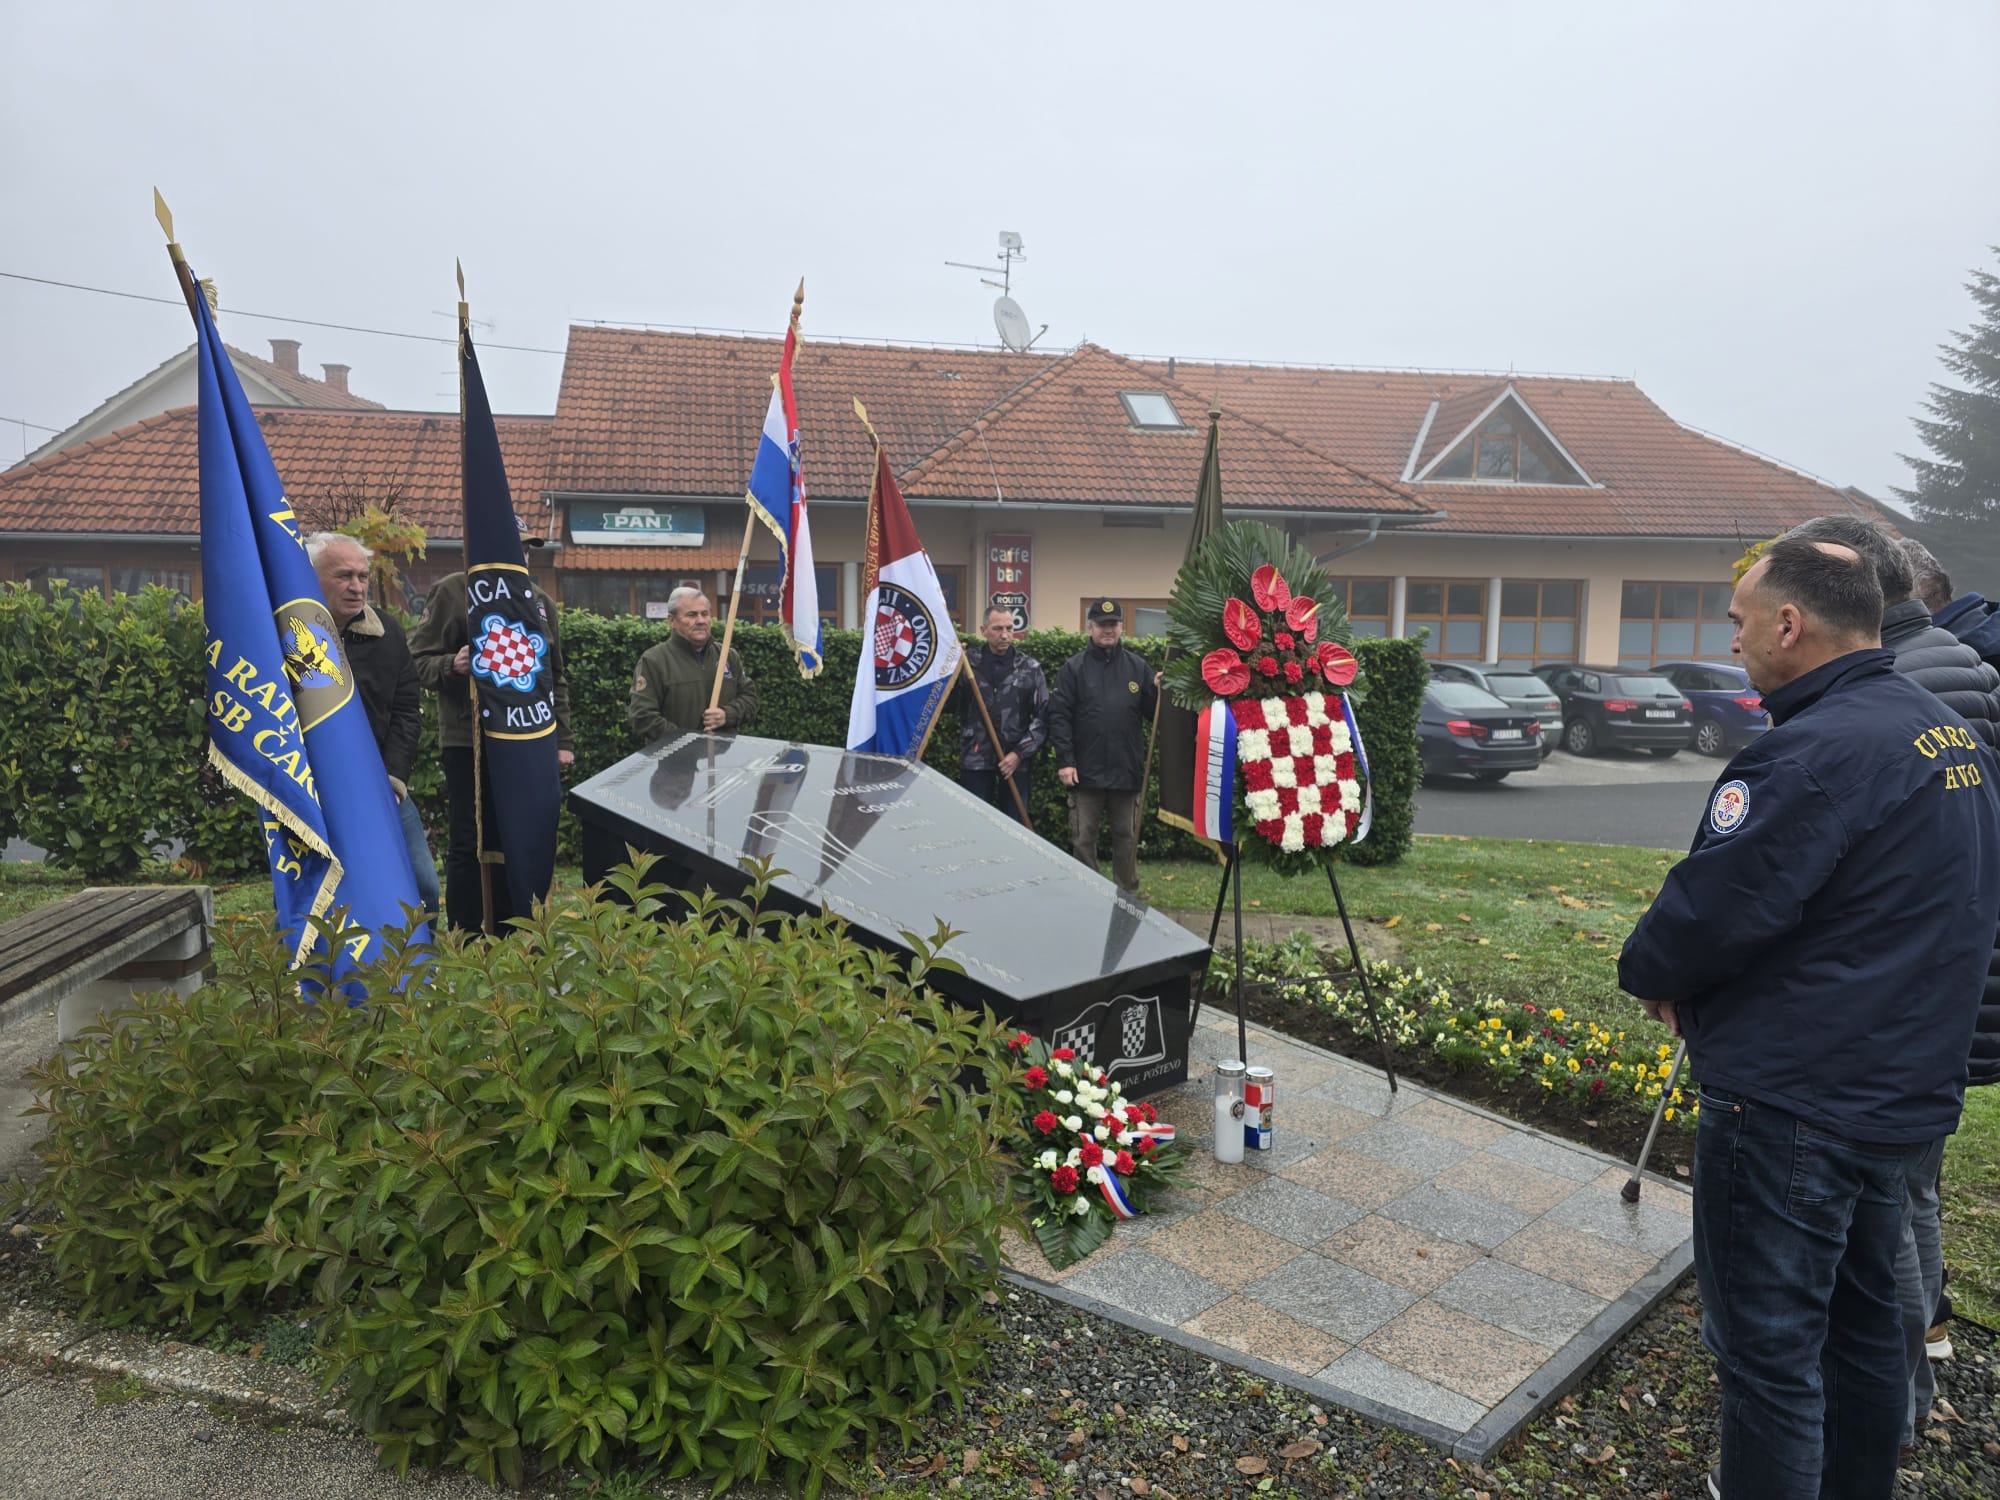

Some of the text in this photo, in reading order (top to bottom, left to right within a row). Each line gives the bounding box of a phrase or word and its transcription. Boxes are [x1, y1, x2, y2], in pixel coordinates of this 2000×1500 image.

[615, 517, 660, 528] PAN
[990, 547, 1029, 562] Caffe
[997, 567, 1022, 583] bar
[996, 596, 1024, 604] ROUTE
[1011, 607, 1025, 630] 6
[887, 614, 930, 684] ZAJEDNO
[506, 700, 552, 728] KLUB
[210, 690, 321, 810] SB ČAK
[1120, 1058, 1182, 1089] GINE POŠTENO
